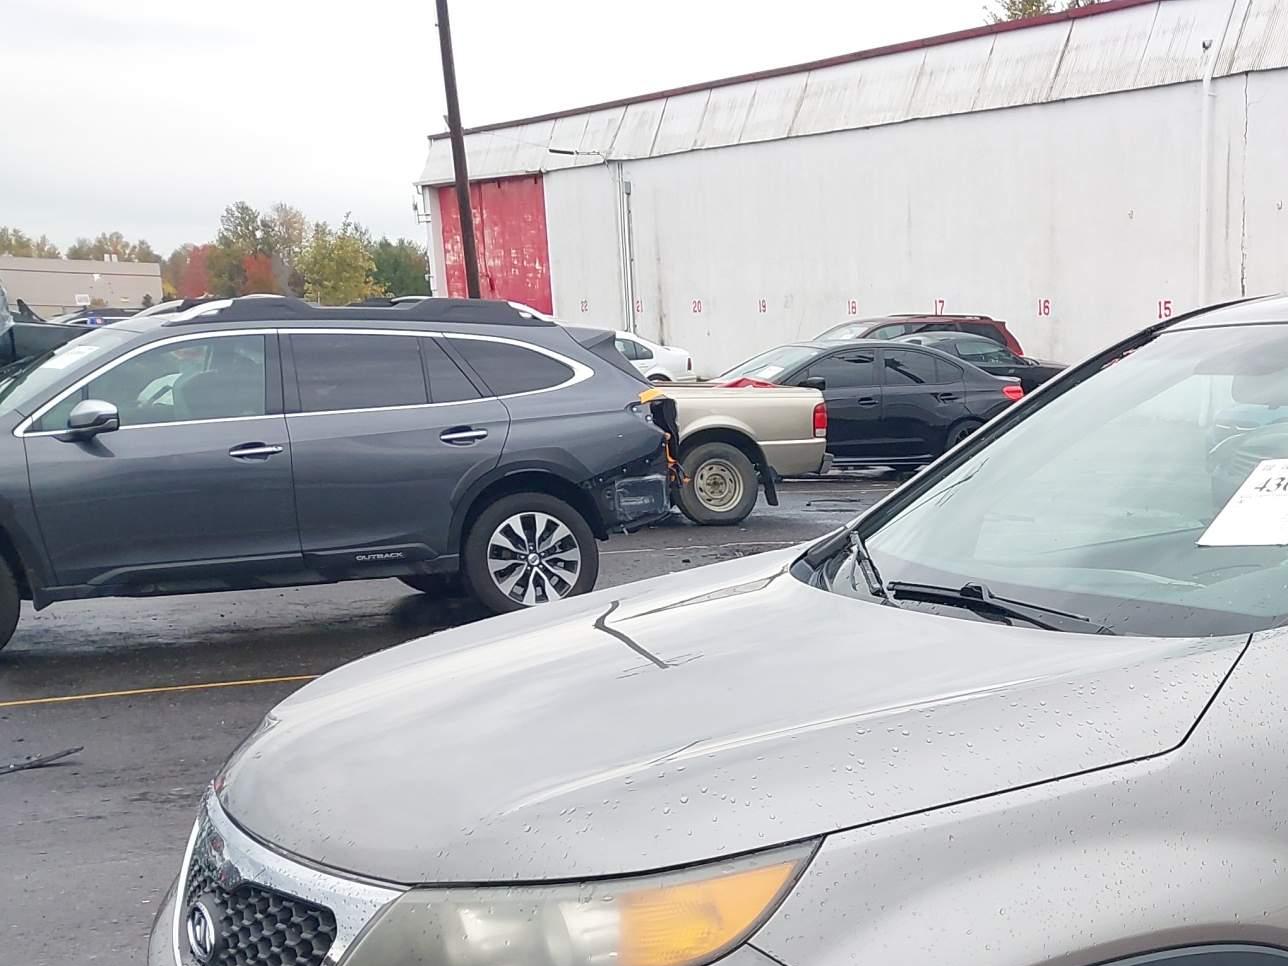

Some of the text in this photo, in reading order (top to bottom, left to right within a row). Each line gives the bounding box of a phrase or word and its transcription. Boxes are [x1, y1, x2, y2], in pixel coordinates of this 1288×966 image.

[692, 299, 702, 313] 20
[758, 299, 767, 313] 19
[847, 300, 857, 315] 18
[934, 299, 945, 315] 17
[1037, 299, 1051, 316] 16
[1157, 300, 1173, 319] 15
[355, 552, 404, 561] OUTBACK
